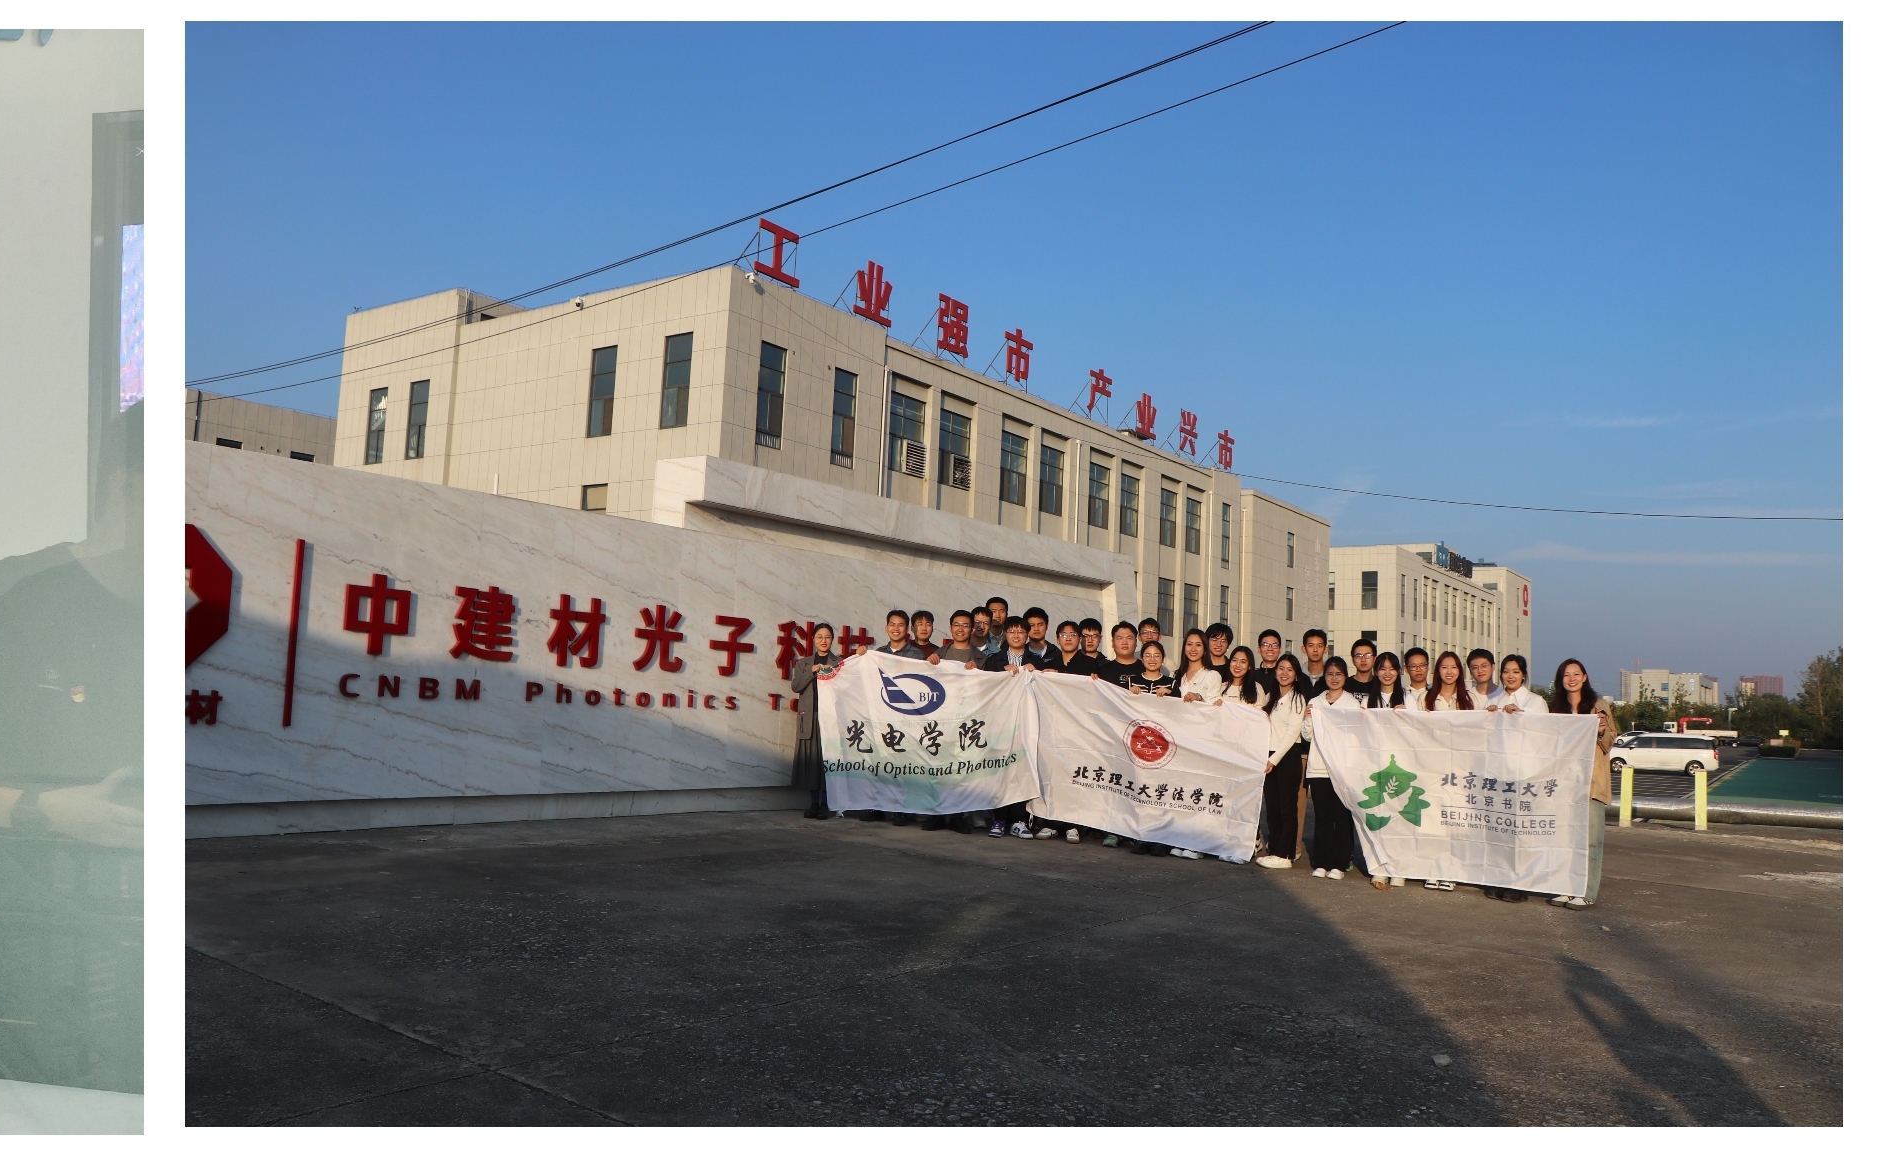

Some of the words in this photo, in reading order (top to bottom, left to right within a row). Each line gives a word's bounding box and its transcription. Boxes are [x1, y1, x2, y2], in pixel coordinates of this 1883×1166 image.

[754, 217, 1033, 383] 工业强市
[1087, 368, 1235, 471] 产业兴市
[339, 672, 482, 702] CNBM
[525, 681, 740, 711] Photonics
[919, 691, 939, 702] BIT
[845, 719, 987, 756] 光电学院
[823, 758, 865, 775] School
[868, 762, 881, 776] of
[884, 762, 925, 778] Optics
[929, 762, 952, 776] and
[956, 752, 1017, 775] Photonics
[1095, 784, 1123, 795] INSTITUTE
[1169, 802, 1195, 811] SCHOOL
[1466, 794, 1532, 811] 北京书院
[1441, 811, 1491, 823] BEIJING
[1496, 817, 1556, 829] COLLEGE
[1468, 823, 1499, 832] INSTITUTE
